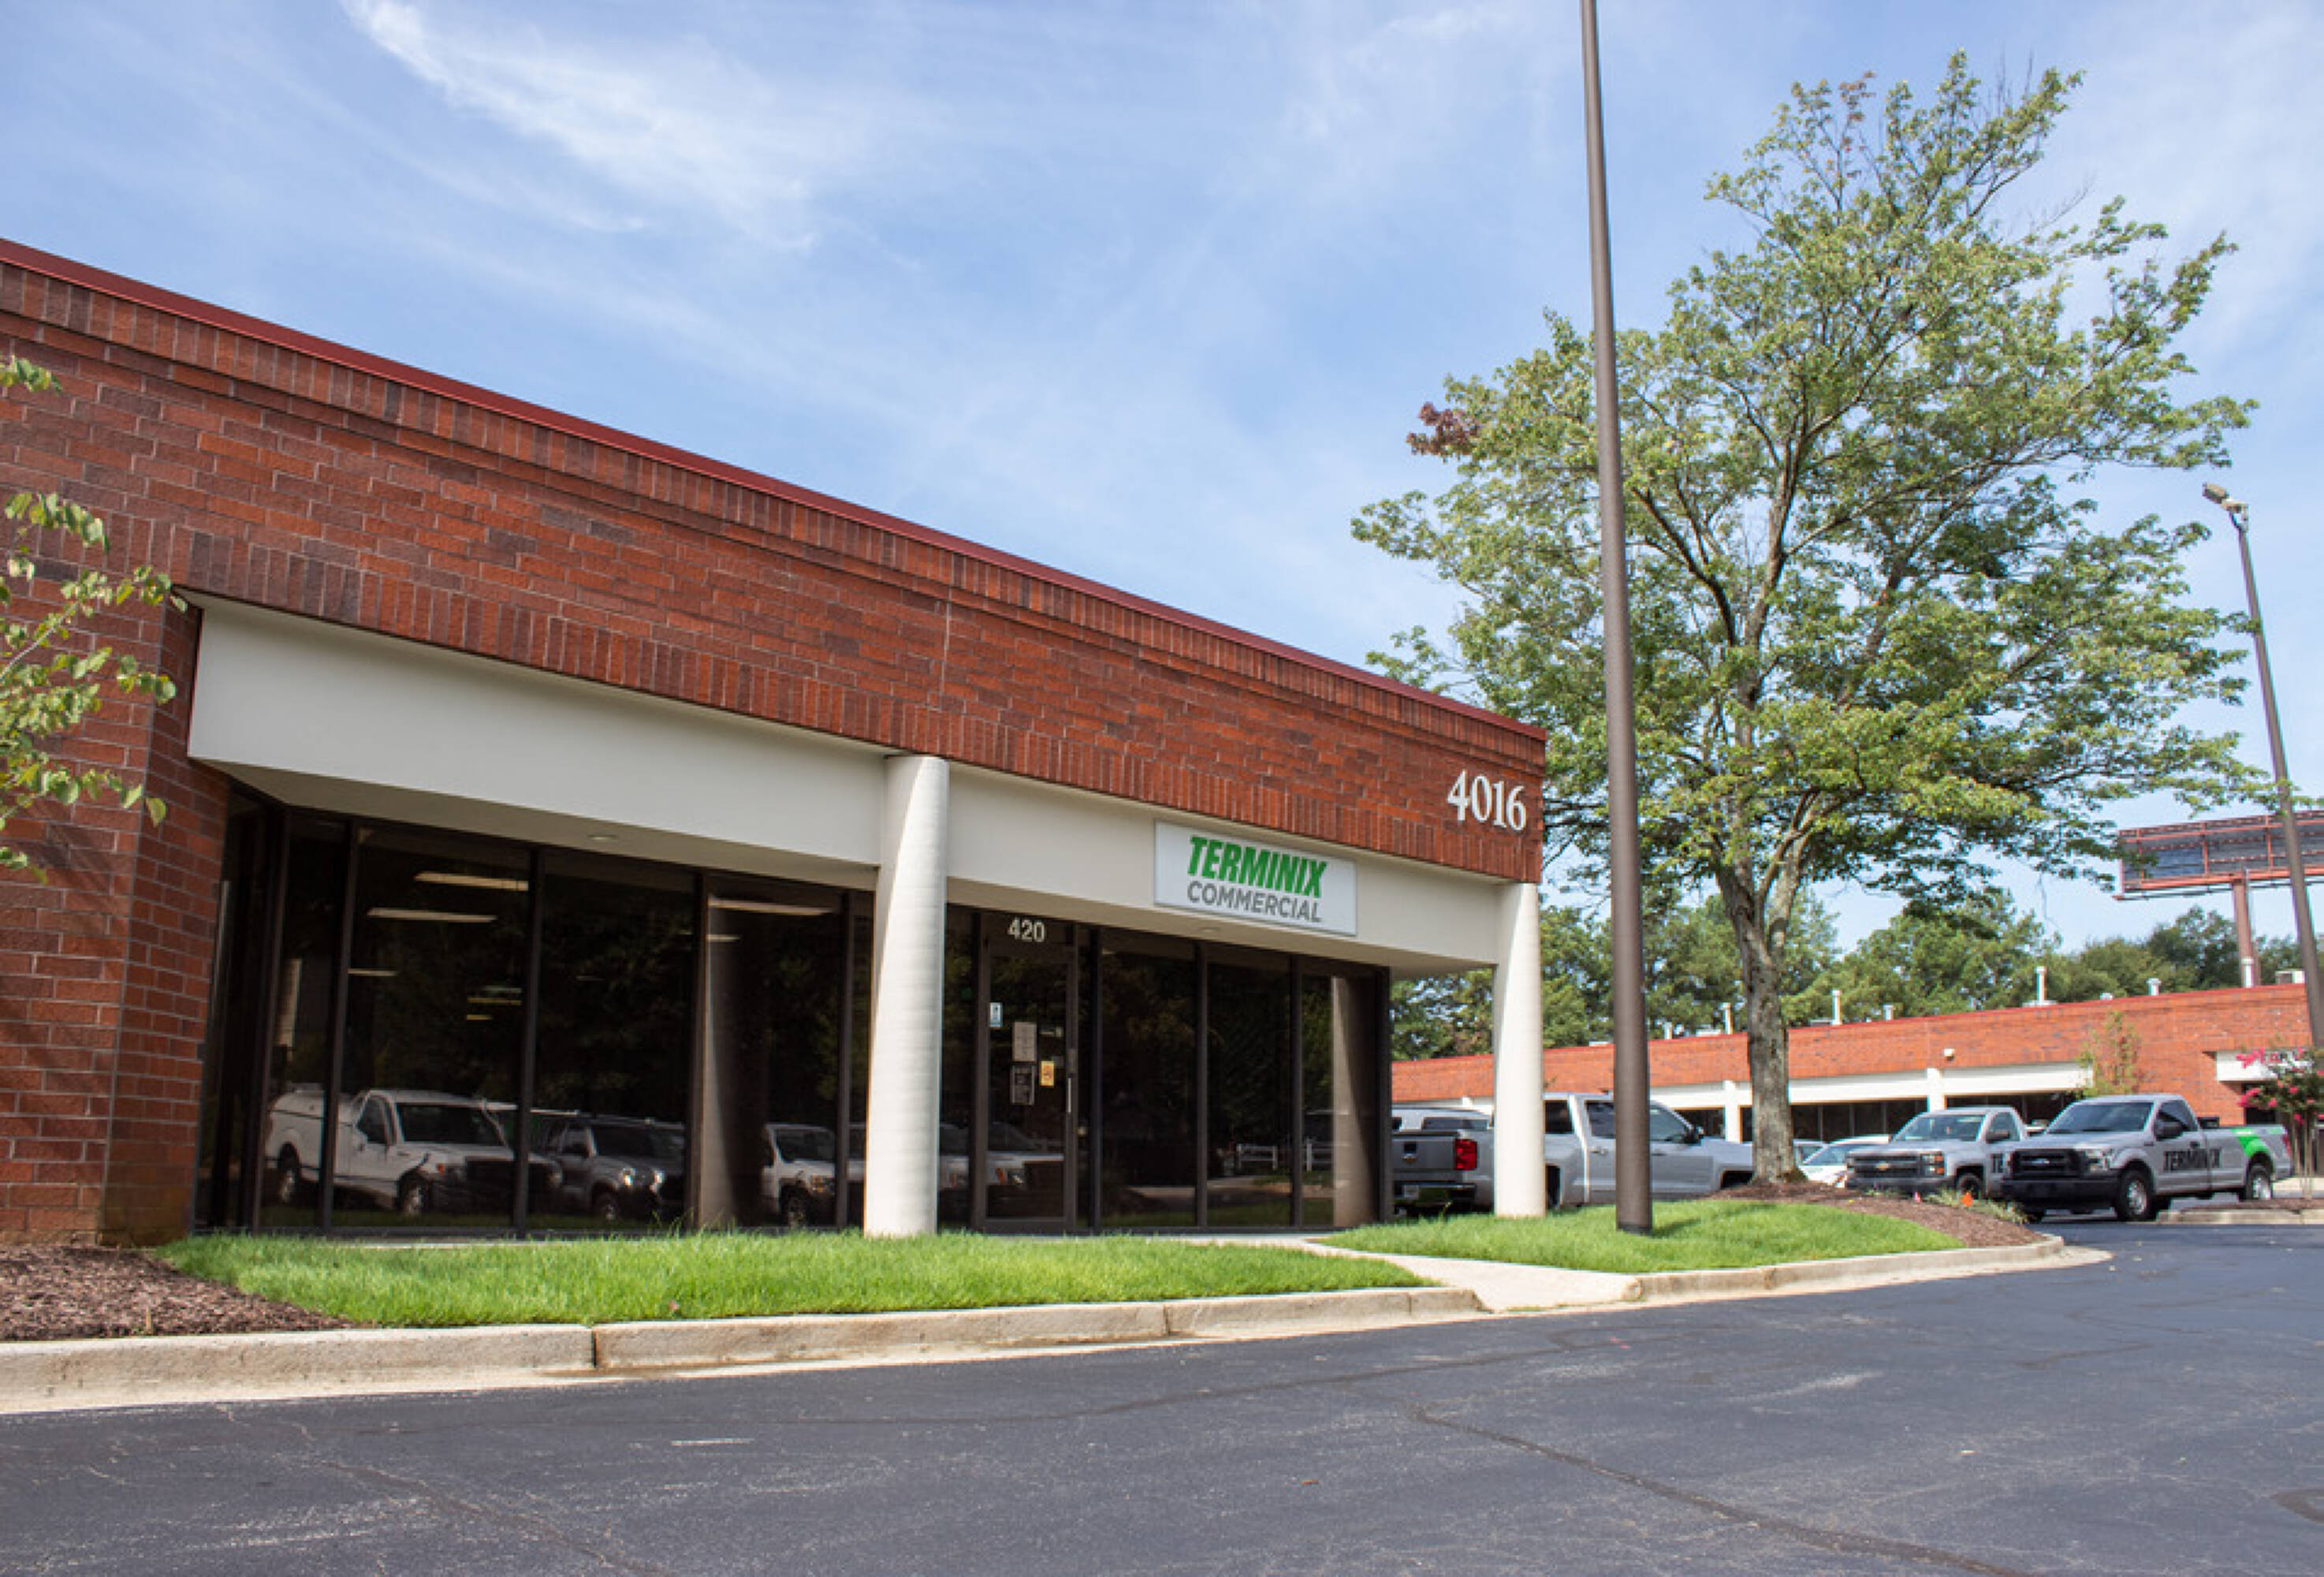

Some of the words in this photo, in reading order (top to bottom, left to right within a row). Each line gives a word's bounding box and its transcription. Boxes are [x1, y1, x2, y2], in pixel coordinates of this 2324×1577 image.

[1447, 769, 1527, 831] 4016
[1186, 836, 1328, 898] TERMINIX
[1186, 881, 1322, 923] COMMERCIAL
[1007, 917, 1045, 942] 420
